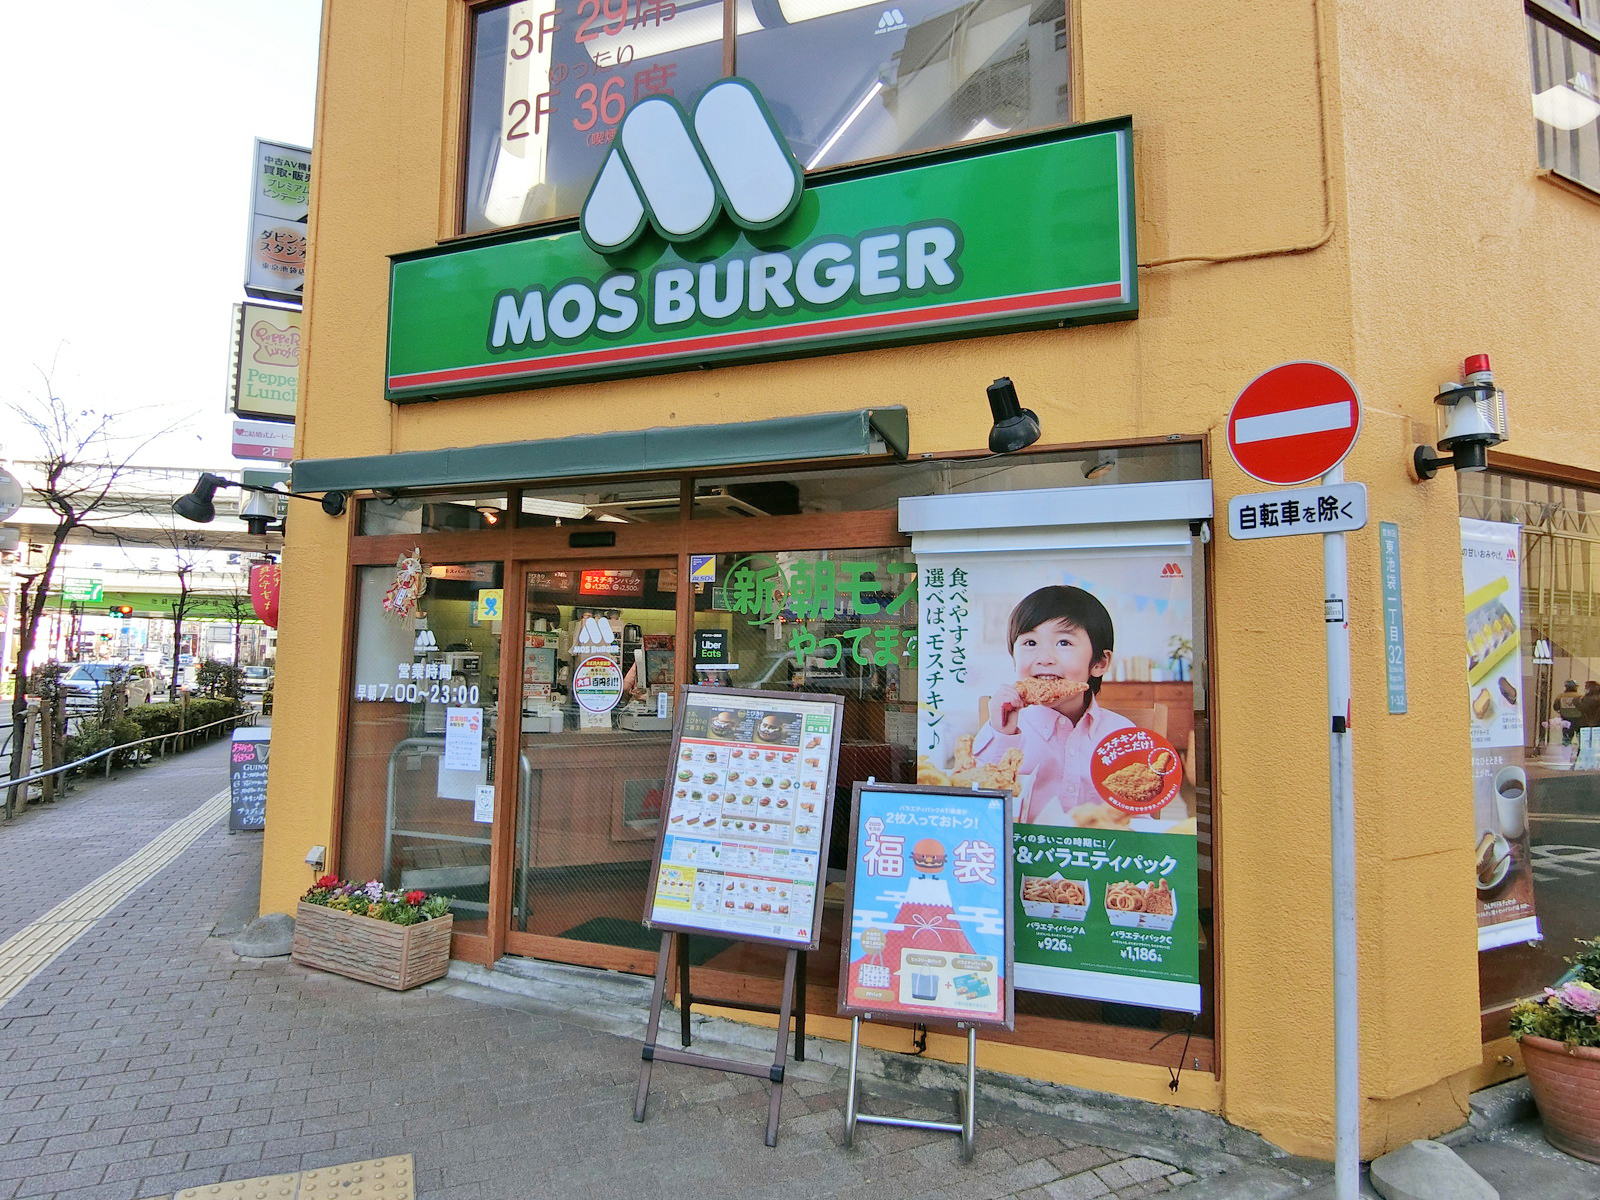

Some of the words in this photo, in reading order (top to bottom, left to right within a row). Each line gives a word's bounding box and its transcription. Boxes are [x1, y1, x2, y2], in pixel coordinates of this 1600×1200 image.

[510, 8, 563, 60] 3F
[547, 44, 635, 85] ゆったり
[506, 89, 560, 141] 2F
[491, 274, 638, 348] MOS
[653, 225, 958, 326] BURGER
[247, 368, 298, 389] Peppe
[262, 446, 280, 457] 2F
[1239, 495, 1353, 530] 自転車を除く
[949, 567, 969, 684] 食べやすさで
[573, 646, 590, 654] MOS
[701, 640, 722, 650] Uber
[701, 649, 722, 658] Eats
[1388, 645, 1402, 665] 32
[398, 662, 453, 680] 営業時間
[1096, 731, 1152, 756] モスチキンは、
[885, 812, 979, 830] 2枚入っておトク!
[863, 833, 906, 877] 福
[953, 840, 997, 885] 袋
[1012, 846, 1177, 876] &バラエティパック
[1026, 922, 1086, 935] バラエティパックA
[1110, 930, 1173, 945] バラエティパックC
